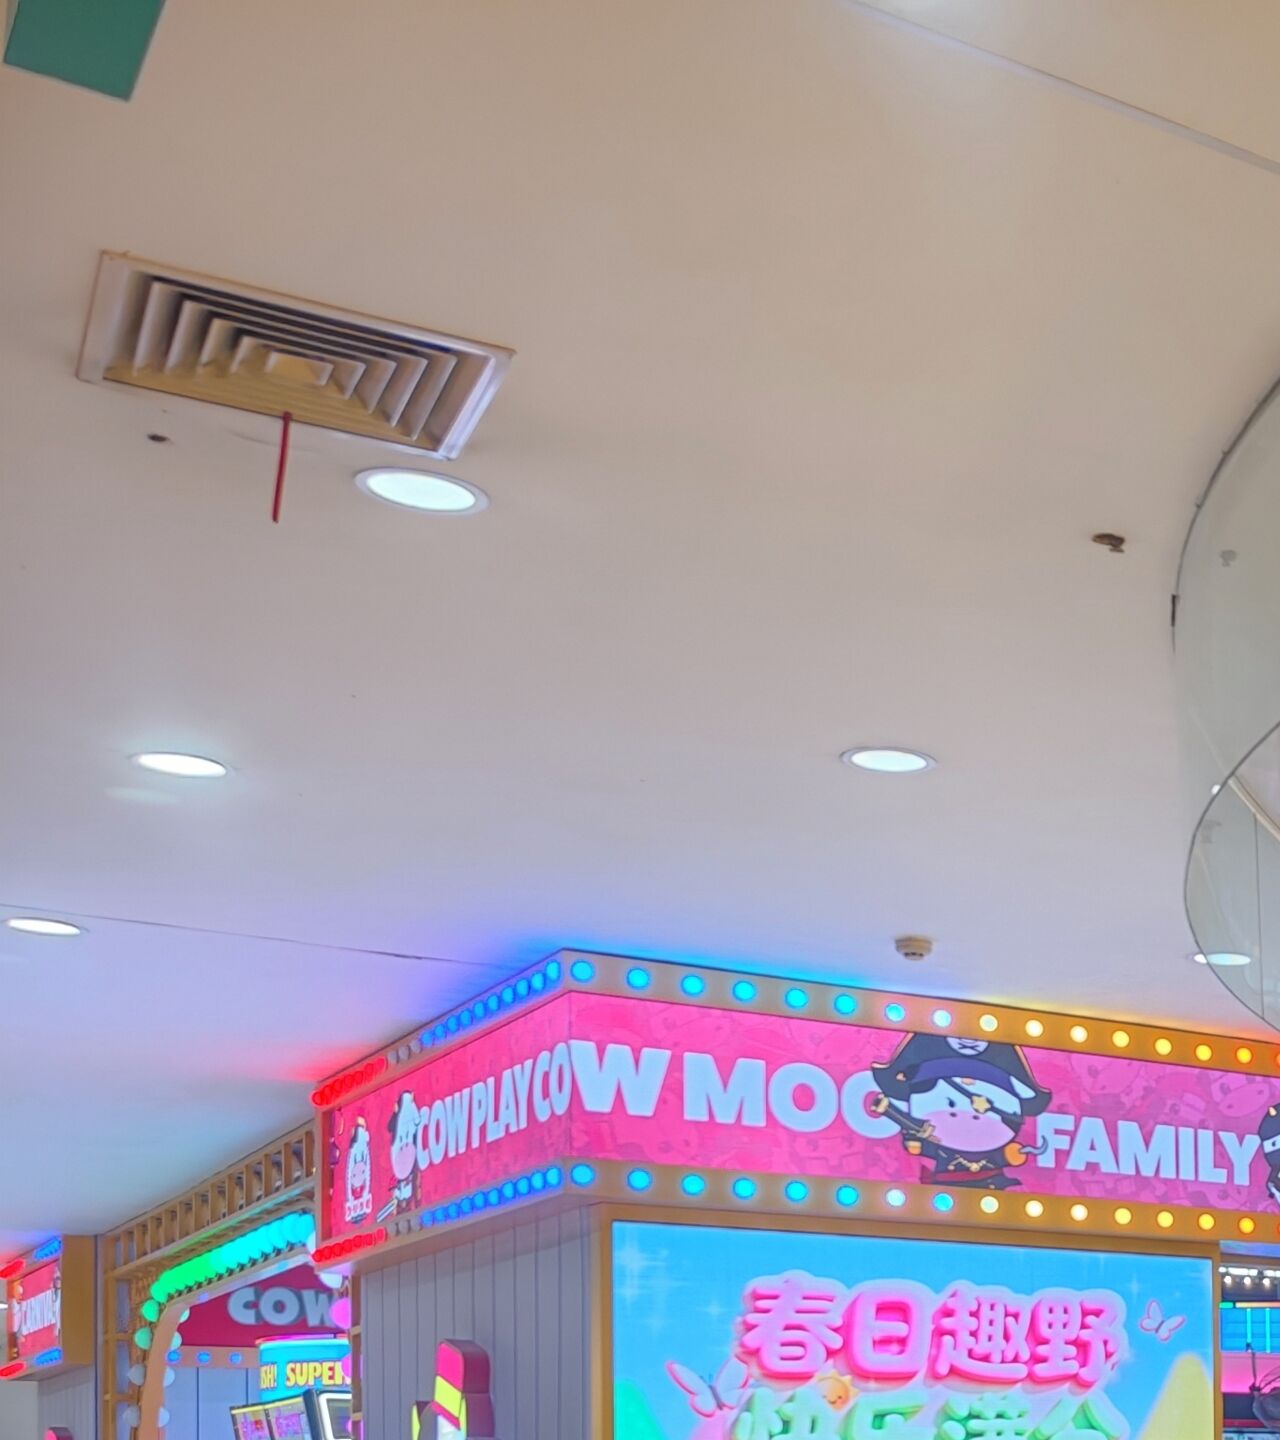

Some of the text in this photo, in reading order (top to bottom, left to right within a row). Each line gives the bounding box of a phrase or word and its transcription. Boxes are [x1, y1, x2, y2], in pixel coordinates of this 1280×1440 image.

[471, 1076, 532, 1154] PLAY
[1037, 1113, 1260, 1186] FAMILY
[742, 1284, 1126, 1387] 春日趣野
[285, 1361, 351, 1388] SUPE
